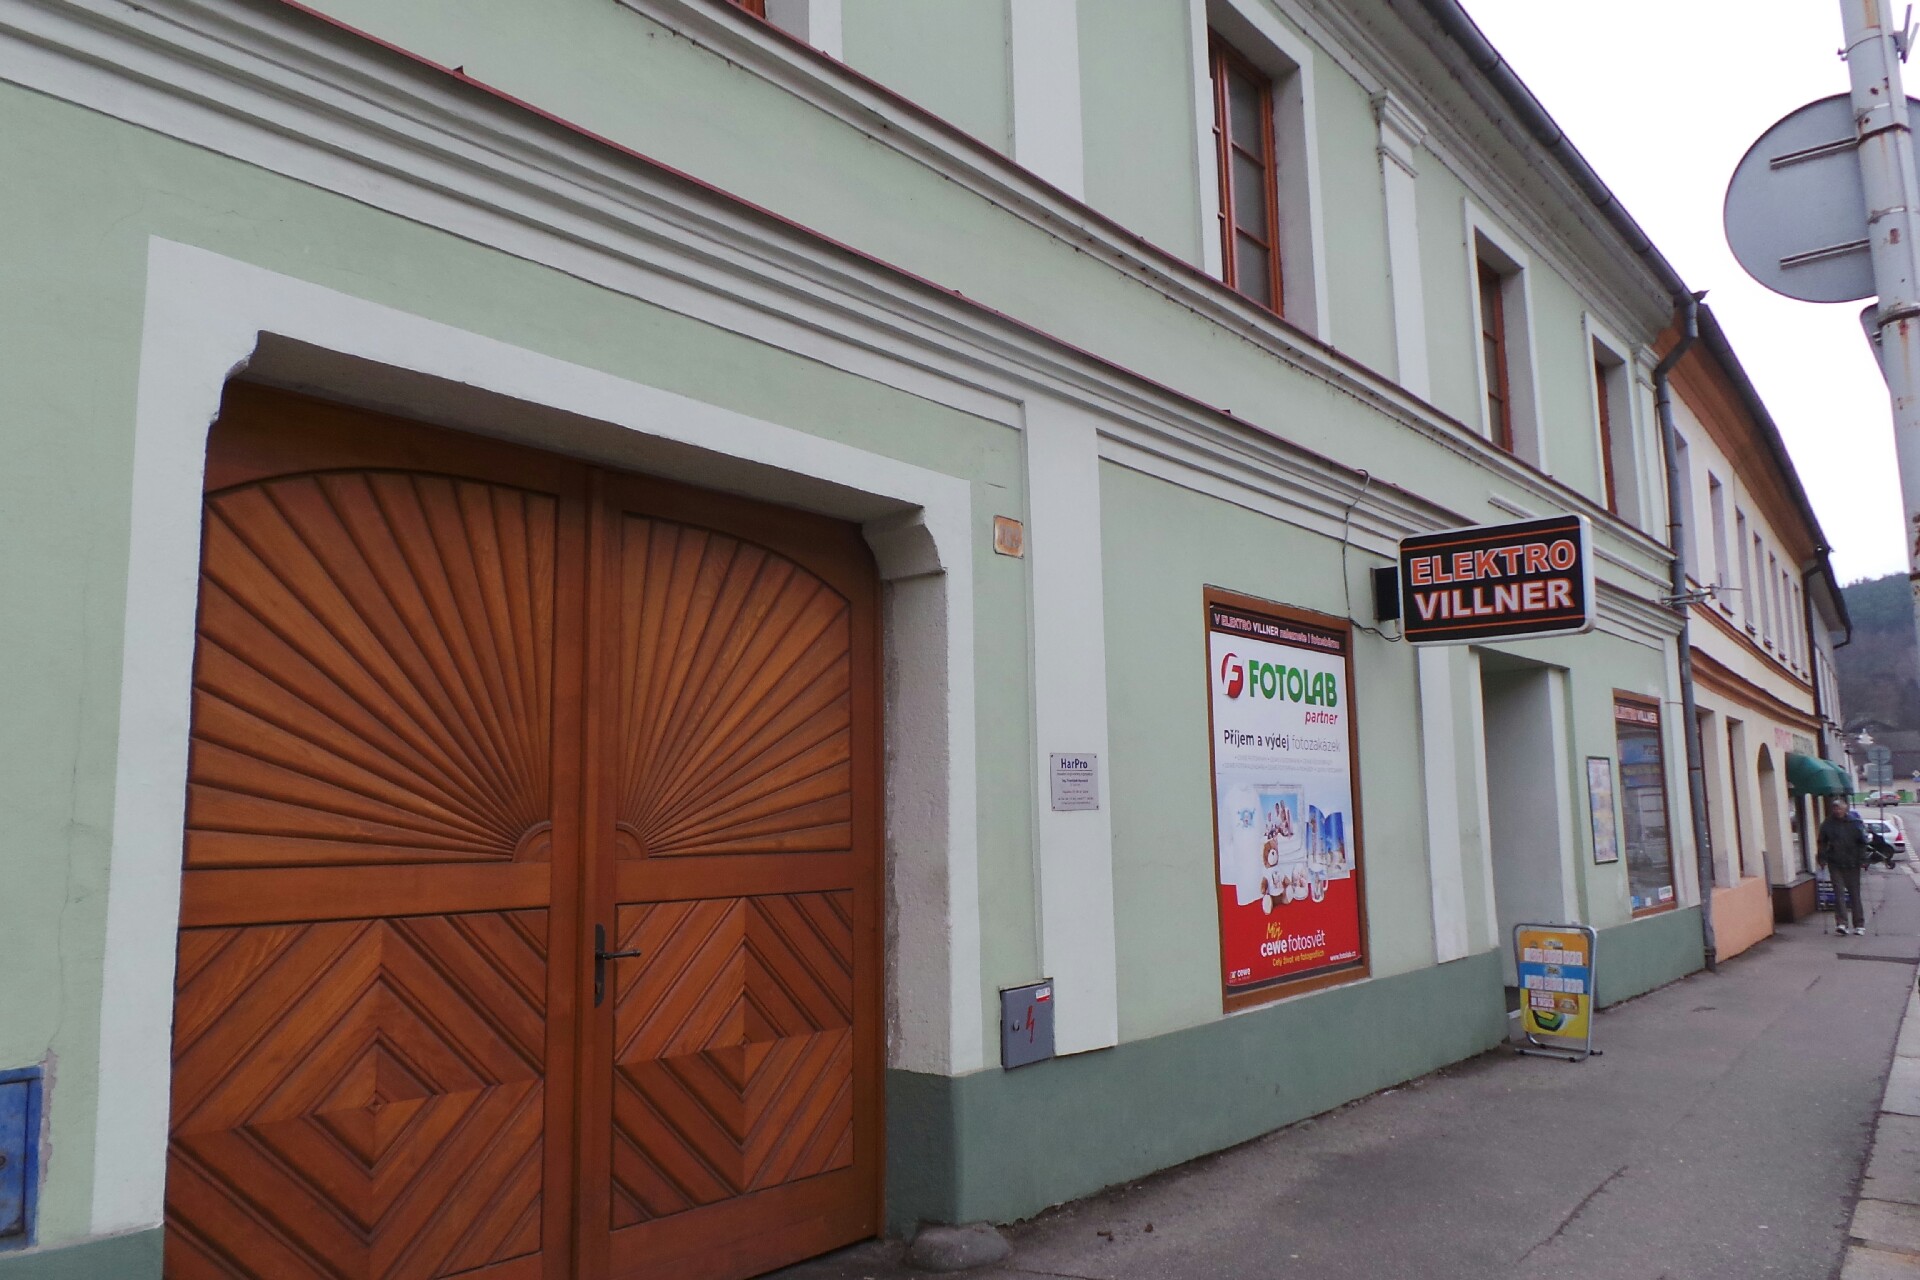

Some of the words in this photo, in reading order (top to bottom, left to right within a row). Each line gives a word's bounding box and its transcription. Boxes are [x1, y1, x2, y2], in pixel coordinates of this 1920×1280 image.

[1410, 539, 1576, 586] ELEKTRO
[1414, 577, 1575, 621] VILLNER
[1214, 613, 1221, 625] V
[1221, 615, 1252, 631] ELEKTRO
[1252, 622, 1279, 637] VILLNER
[1248, 659, 1338, 708] FOTOLAB
[1304, 710, 1338, 725] partner
[1223, 729, 1255, 748] Příjem
[1257, 736, 1263, 747] a
[1264, 733, 1290, 751] výdej
[1292, 735, 1341, 752] fotozakázek
[1060, 758, 1088, 769] HarPro
[1260, 939, 1287, 957] cewe
[1287, 930, 1326, 952] fotosvět
